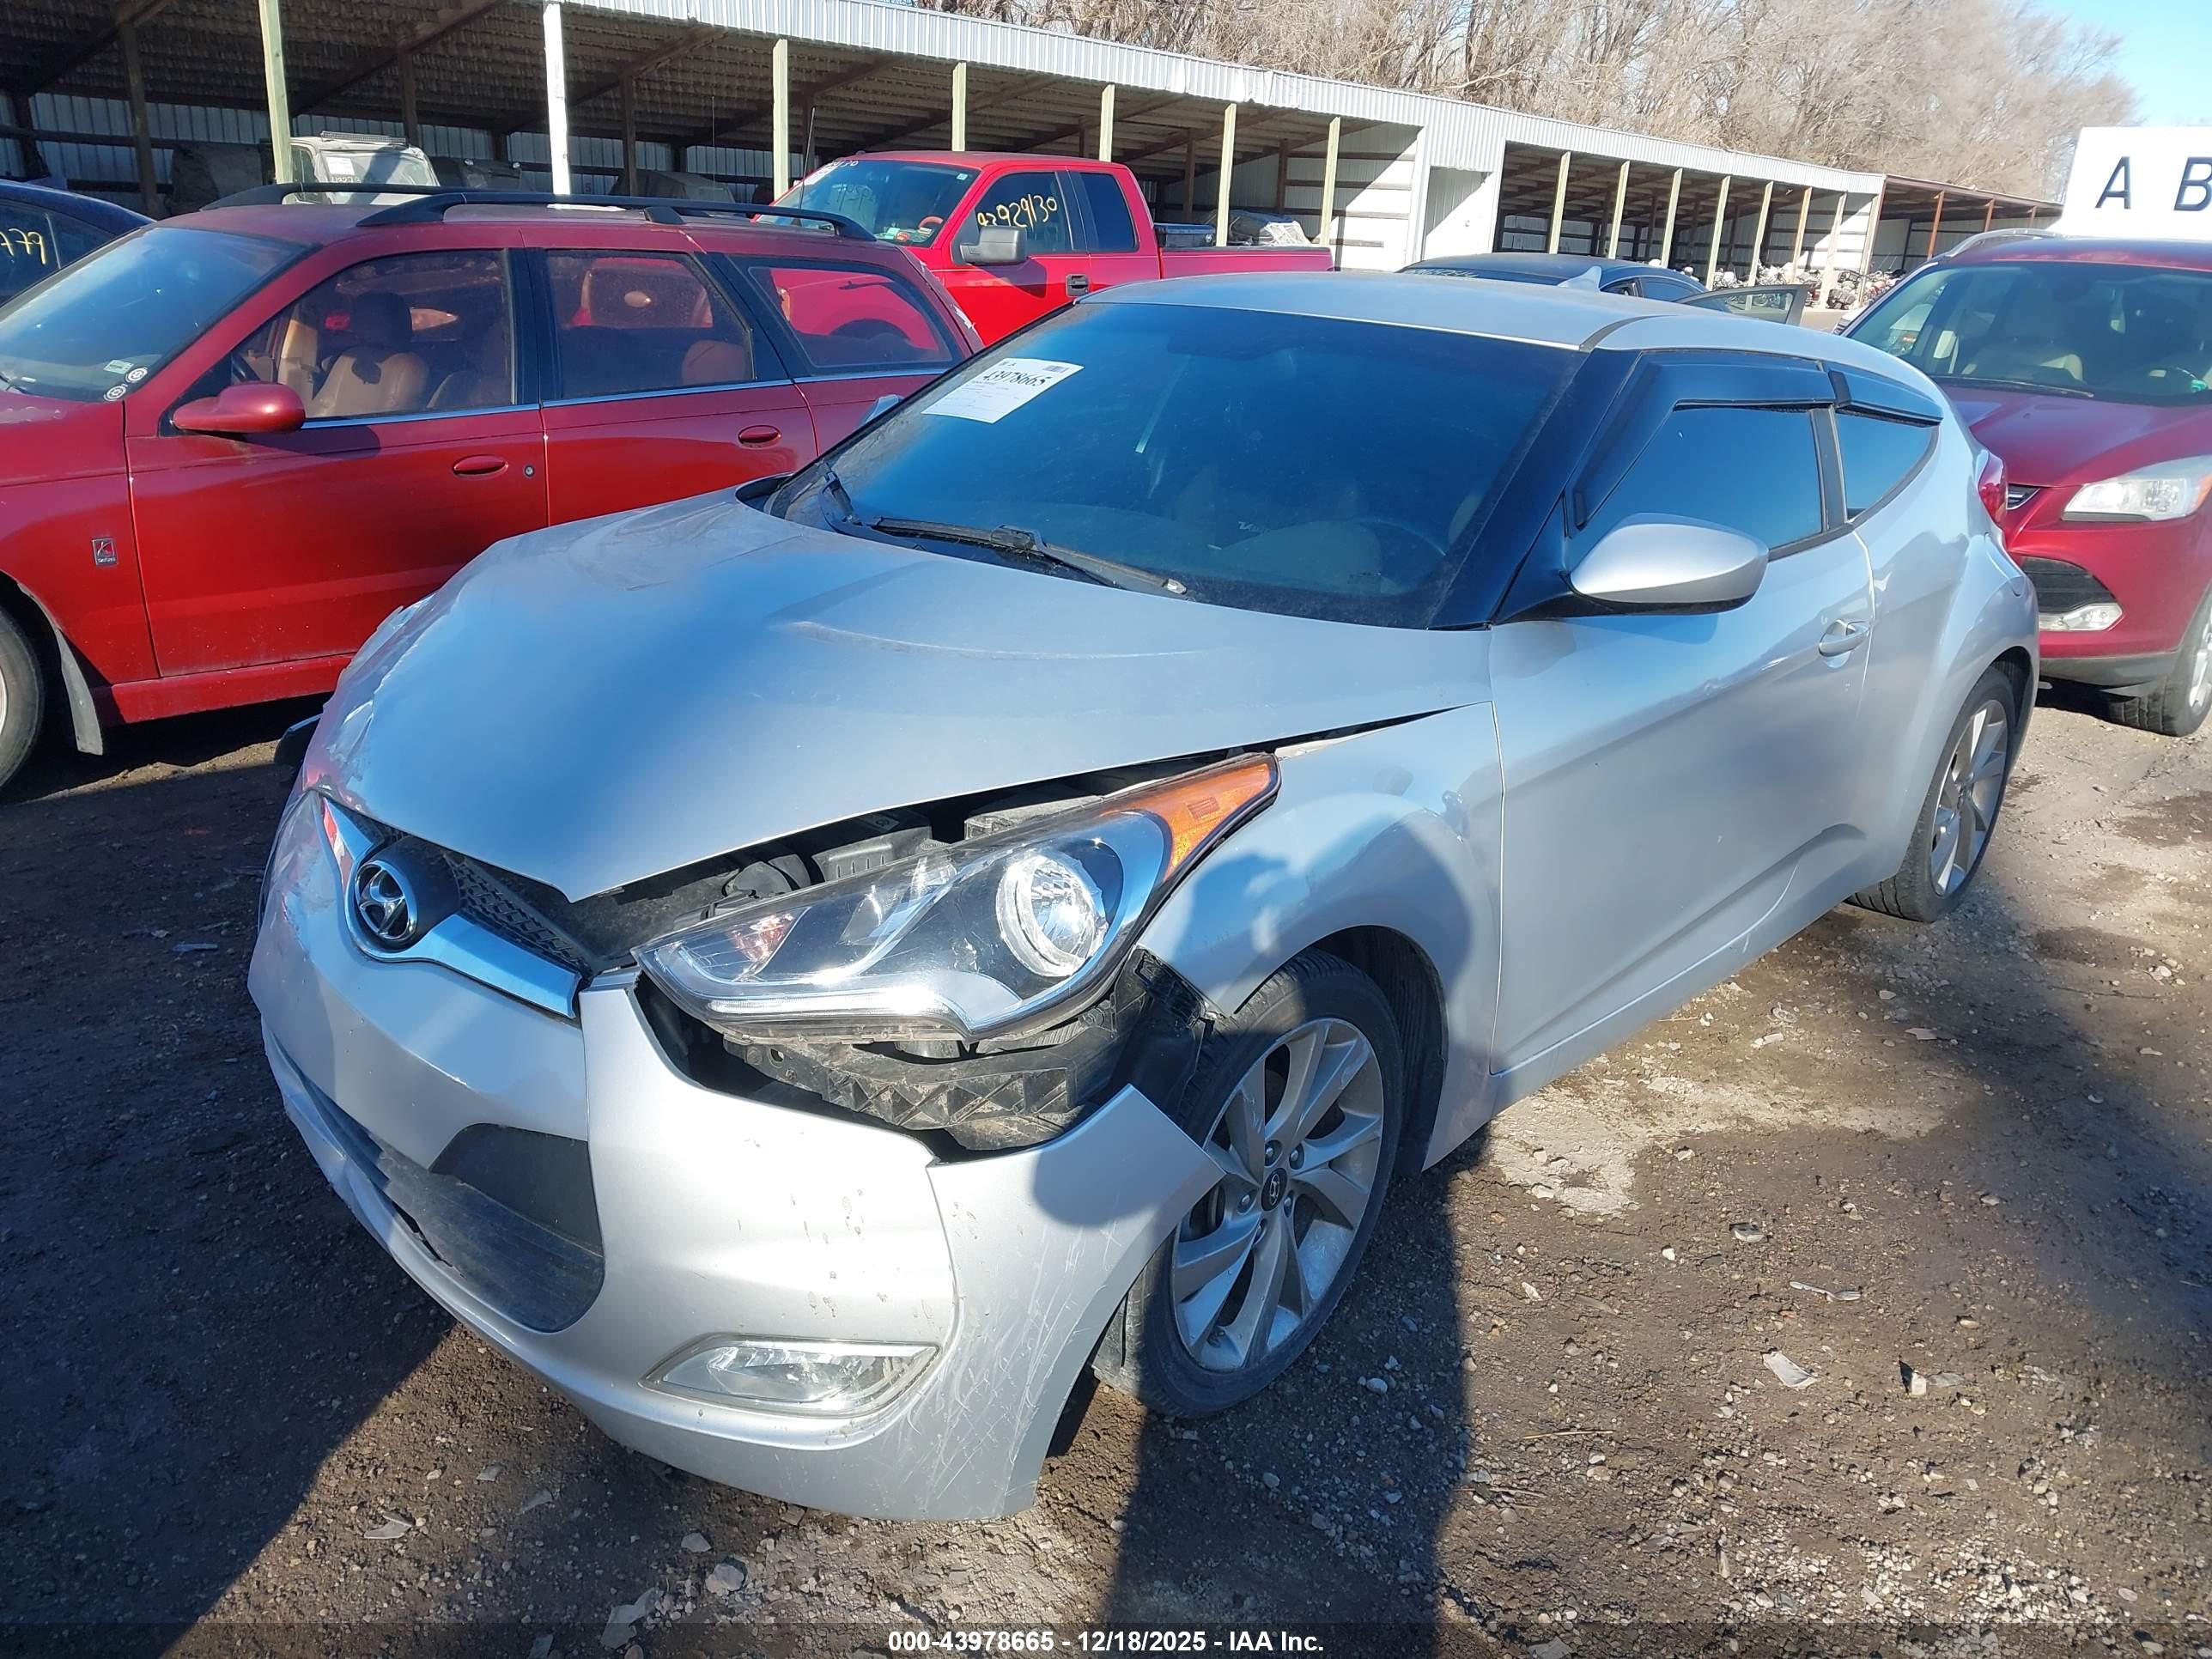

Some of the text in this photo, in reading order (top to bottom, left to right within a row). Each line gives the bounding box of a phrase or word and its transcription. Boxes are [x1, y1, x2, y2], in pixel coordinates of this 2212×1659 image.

[2094, 155, 2212, 211] A B
[981, 370, 1053, 386] 43978665
